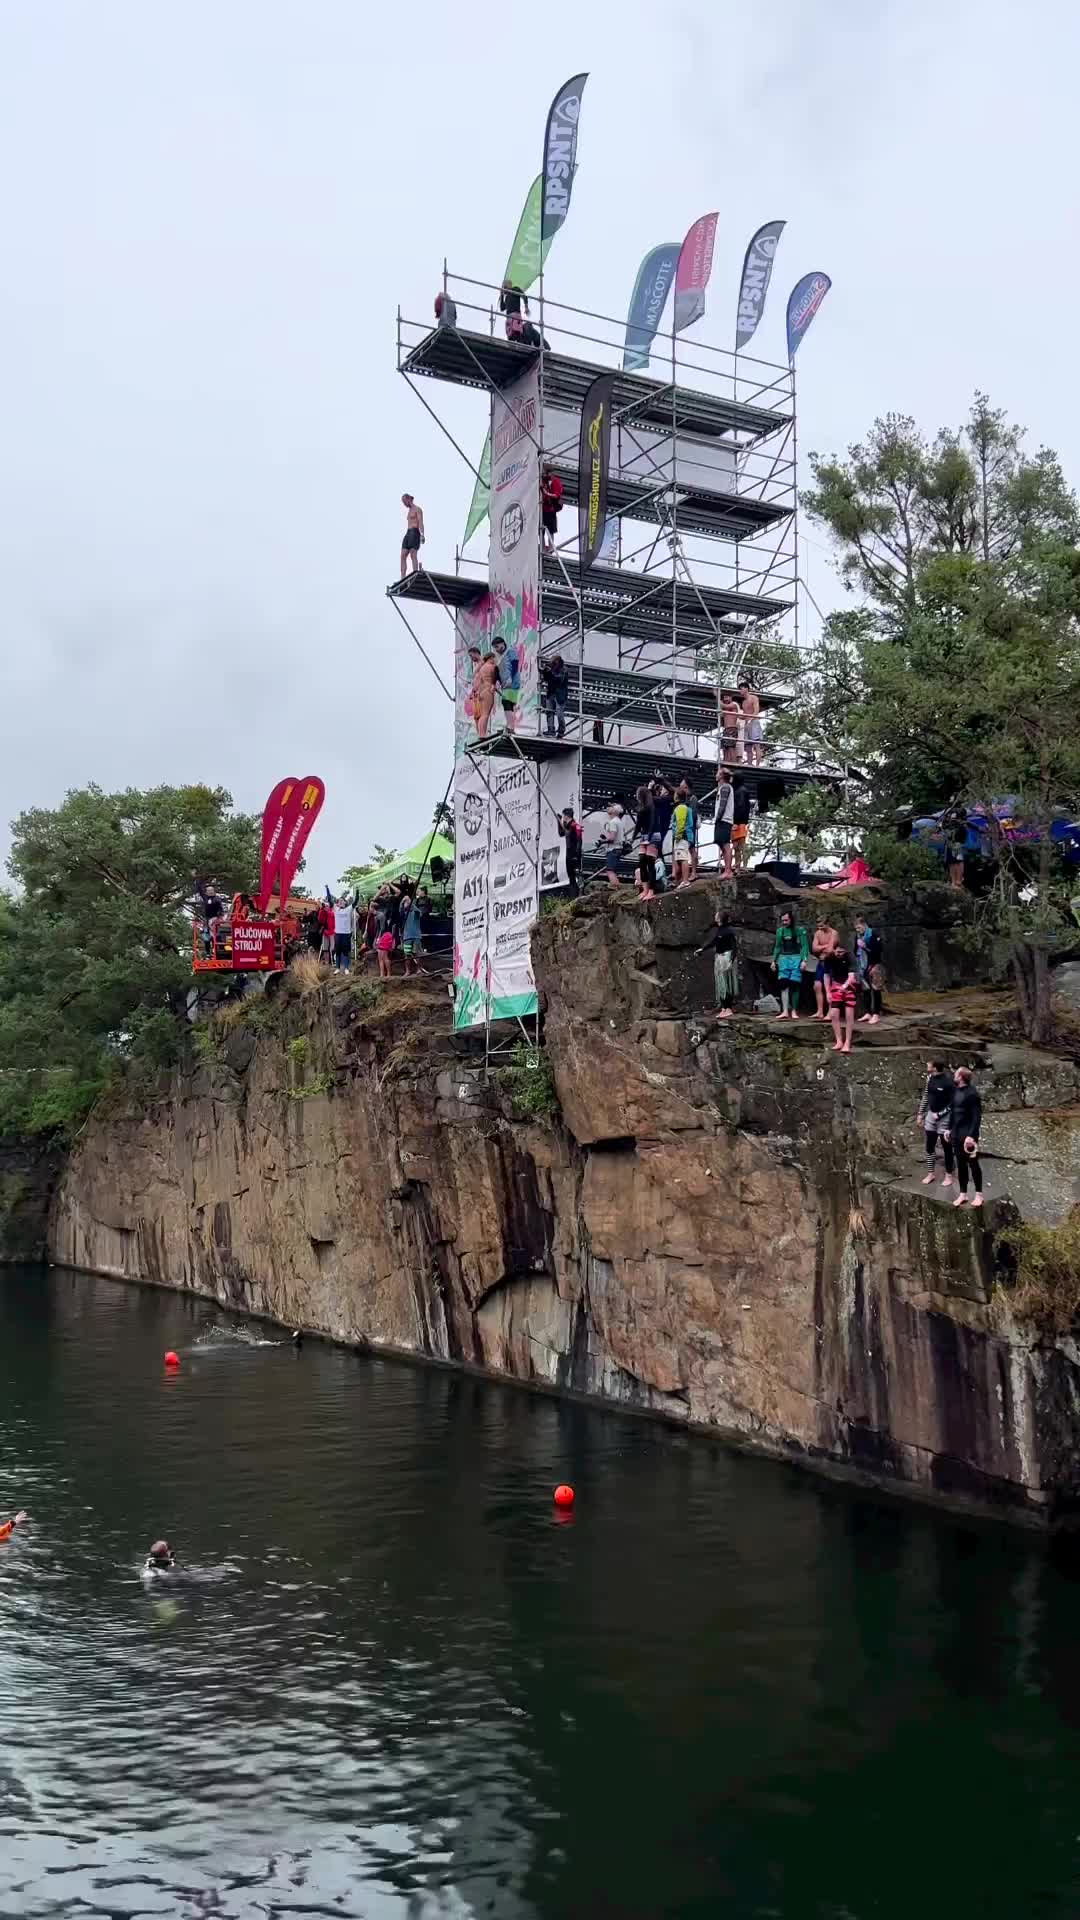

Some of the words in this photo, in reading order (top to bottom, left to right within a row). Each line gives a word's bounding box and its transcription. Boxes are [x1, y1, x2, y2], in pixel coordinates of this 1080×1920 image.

[545, 122, 574, 216] RPSNT
[646, 259, 673, 327] MASCOTTE
[738, 253, 770, 334] RPSNT
[265, 815, 285, 863] ZEPPELIN
[284, 815, 305, 862] ZEPPELIN
[493, 827, 532, 853] SAMSUNG
[499, 896, 533, 919] RPSNT
[234, 926, 273, 939] PŮJČOVNA
[234, 939, 263, 952] STROJŮ
